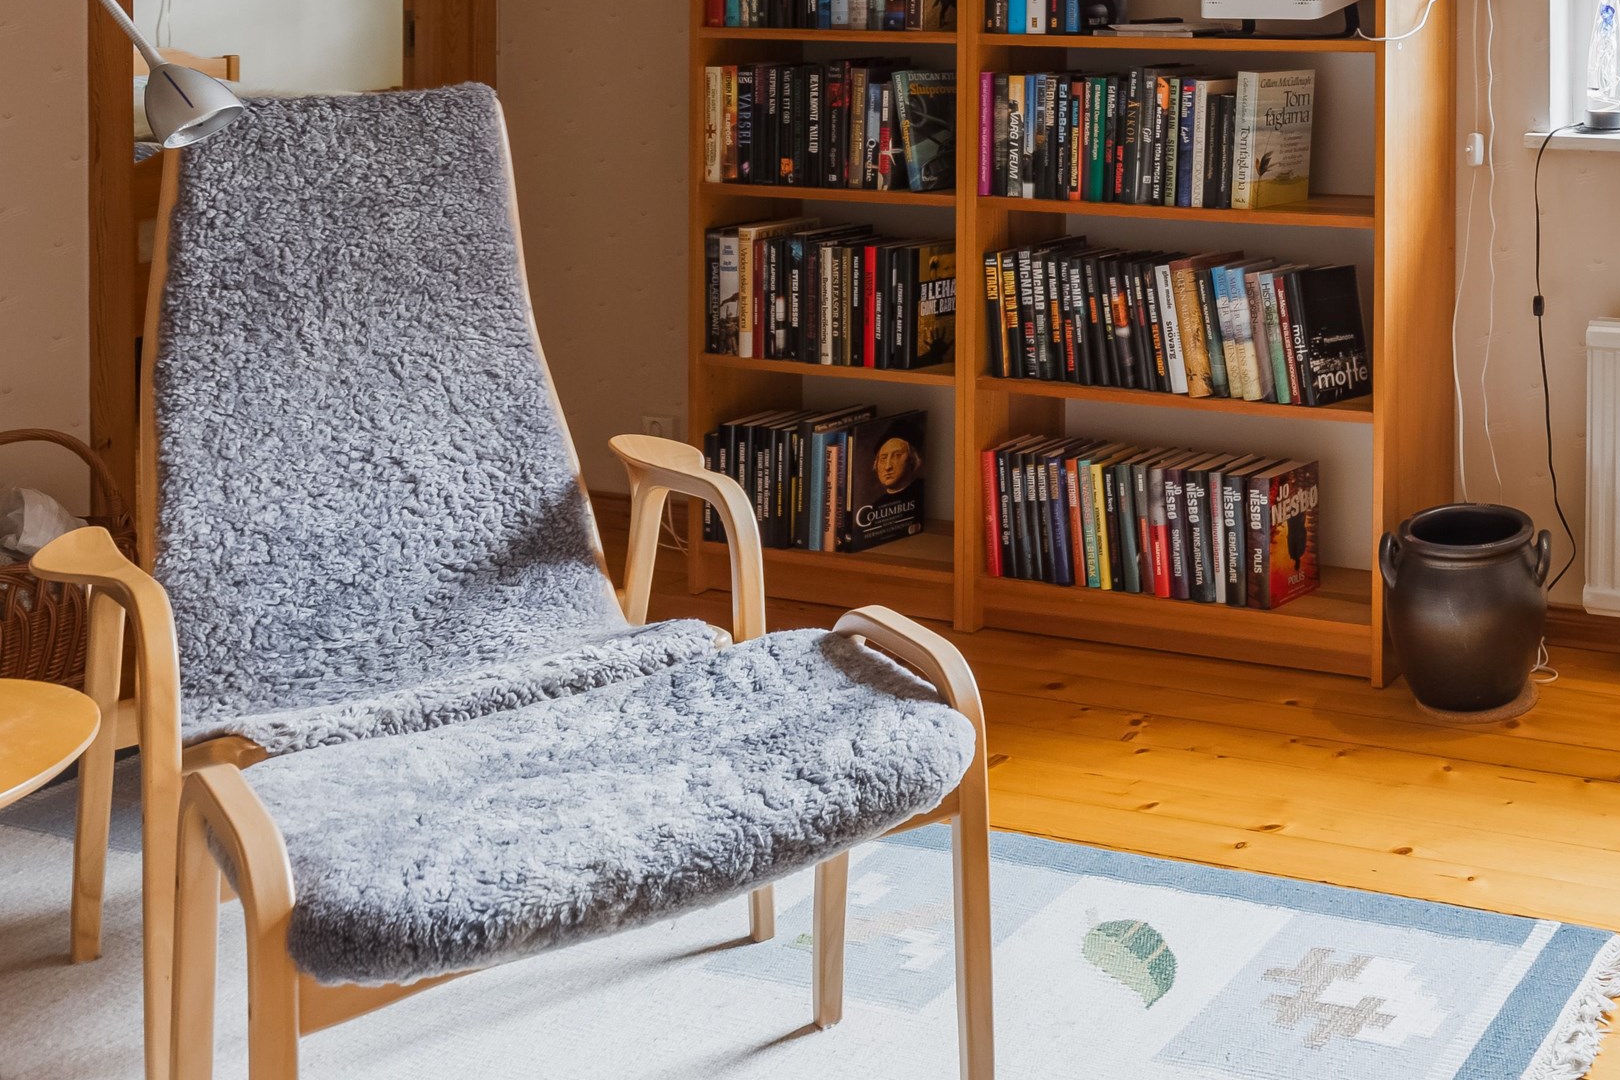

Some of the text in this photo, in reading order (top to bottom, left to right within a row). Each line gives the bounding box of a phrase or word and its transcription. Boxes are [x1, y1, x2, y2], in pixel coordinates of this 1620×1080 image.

[894, 74, 904, 102] DUNCAN
[738, 93, 752, 148] VARSEL
[1009, 112, 1019, 139] VARG
[1058, 84, 1068, 144] Ed McBain
[1009, 148, 1019, 180] VEUM
[985, 266, 998, 300] ATTACK!
[1003, 270, 1016, 294] BRAVO
[1019, 259, 1033, 305] McNAB
[1061, 261, 1069, 282] ANDY
[1033, 268, 1045, 311] McNAB
[1247, 281, 1259, 324] HISTORIEN
[1262, 283, 1275, 327] HISTORIEN
[1162, 271, 1178, 360] glenn meade snövarg
[1152, 324, 1161, 349] SEVEN
[1293, 324, 1309, 362] motte
[1317, 356, 1369, 390] motte
[1173, 483, 1183, 495] JO
[1195, 486, 1205, 498] JO
[1232, 490, 1242, 502] JO
[1259, 493, 1268, 505] JO
[1271, 484, 1318, 527] NESBØ
[1276, 482, 1289, 502] JO
[856, 499, 916, 528] COLUMBUS
[1165, 481, 1182, 577] NESBØ SNÖMANNEN
[1185, 482, 1204, 585] NESBØ PANSARHJÄRTA
[1223, 486, 1238, 584] NESBØ GENGÅNGARE
[1249, 489, 1263, 575] NESBØ POLIS
[1287, 570, 1305, 586] POLIS
